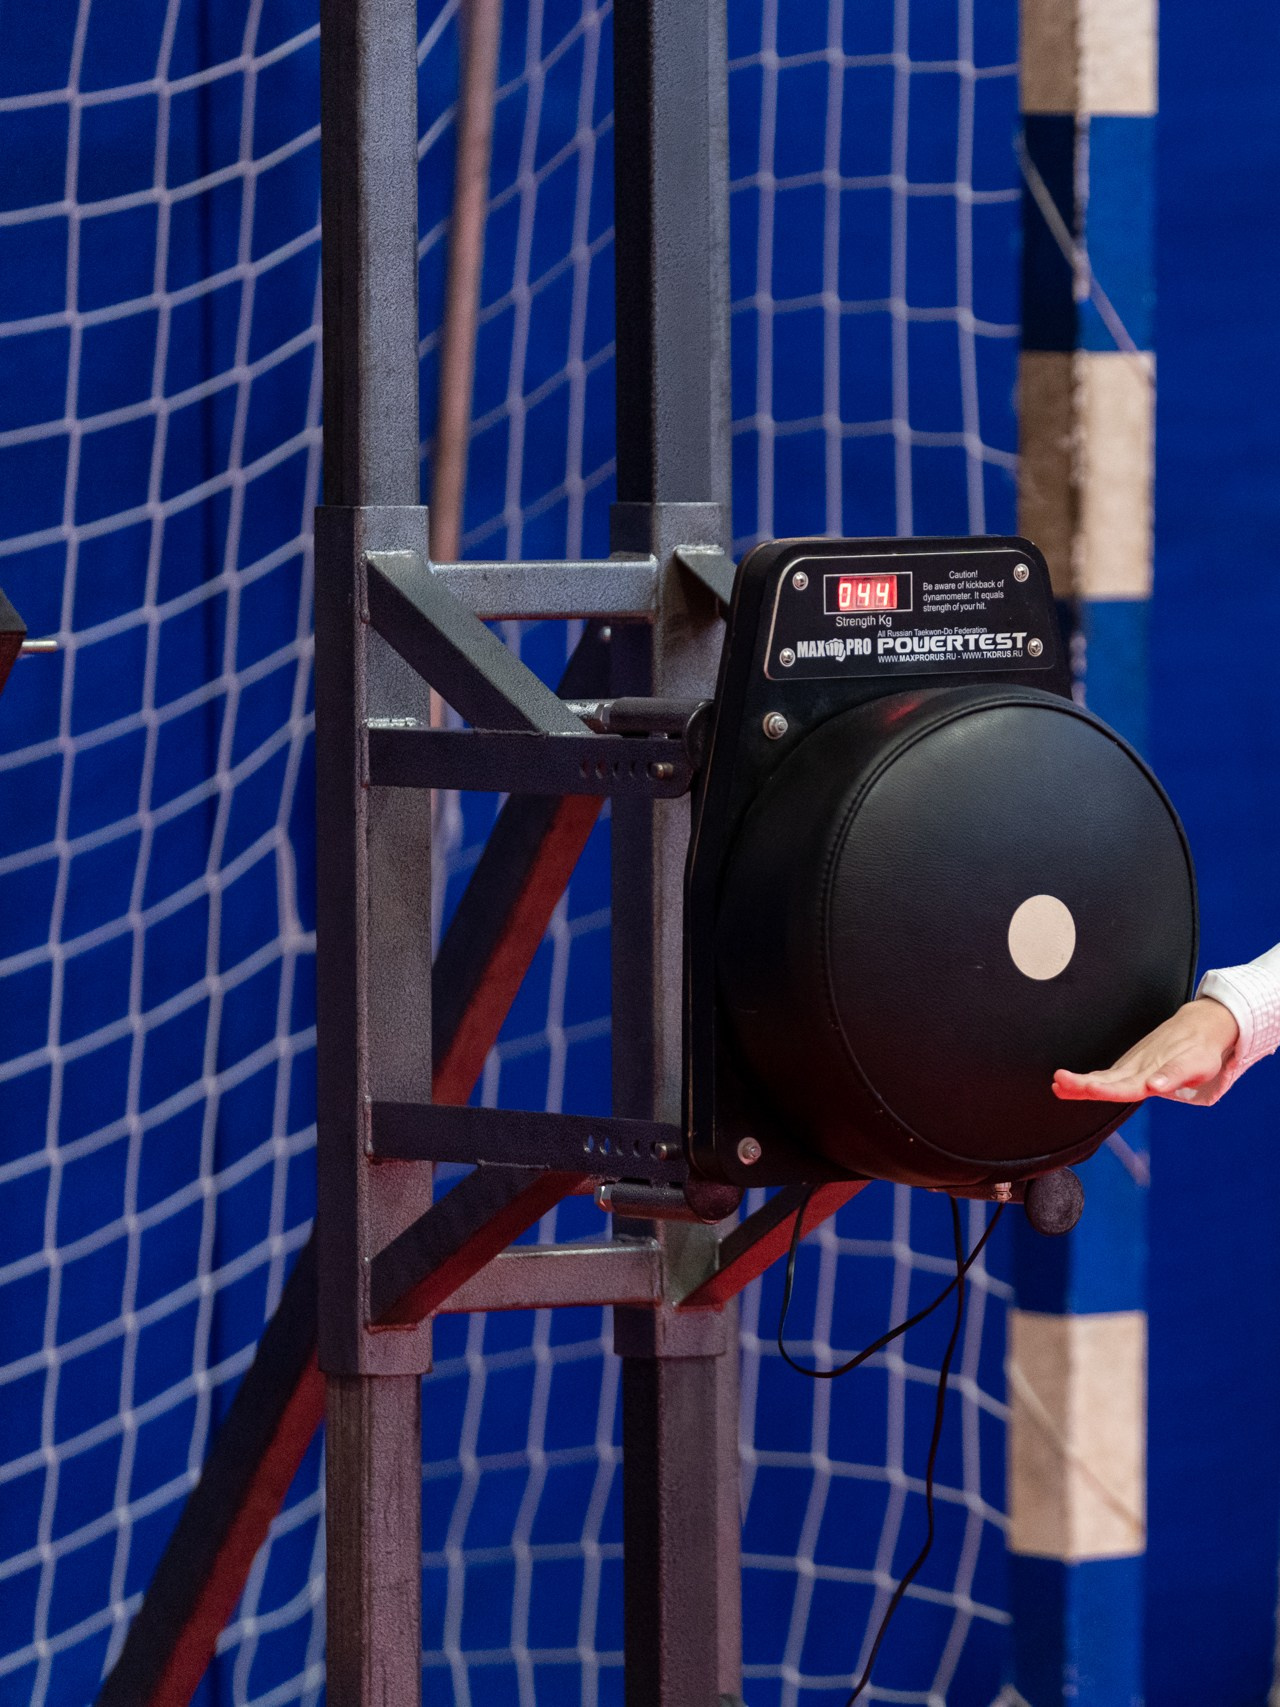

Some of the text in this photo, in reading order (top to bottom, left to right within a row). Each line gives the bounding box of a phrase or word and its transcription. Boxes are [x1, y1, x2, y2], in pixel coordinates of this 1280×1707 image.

[948, 570, 978, 579] Caution!
[923, 579, 1004, 591] Be aware of kickback of
[839, 583, 889, 607] 044
[923, 590, 1004, 603] dynamometer. It equals
[923, 601, 986, 613] strength of your hit.
[836, 614, 892, 628] Strength Kg
[877, 626, 987, 638] All Russian Taekwon-Do Federation
[797, 638, 872, 658] MAX PRO
[877, 632, 1027, 654] POWERTEST
[878, 652, 957, 663] WWW.MAXPRORUS.RU
[961, 650, 1023, 660] WWW.TKDRUS.RU
